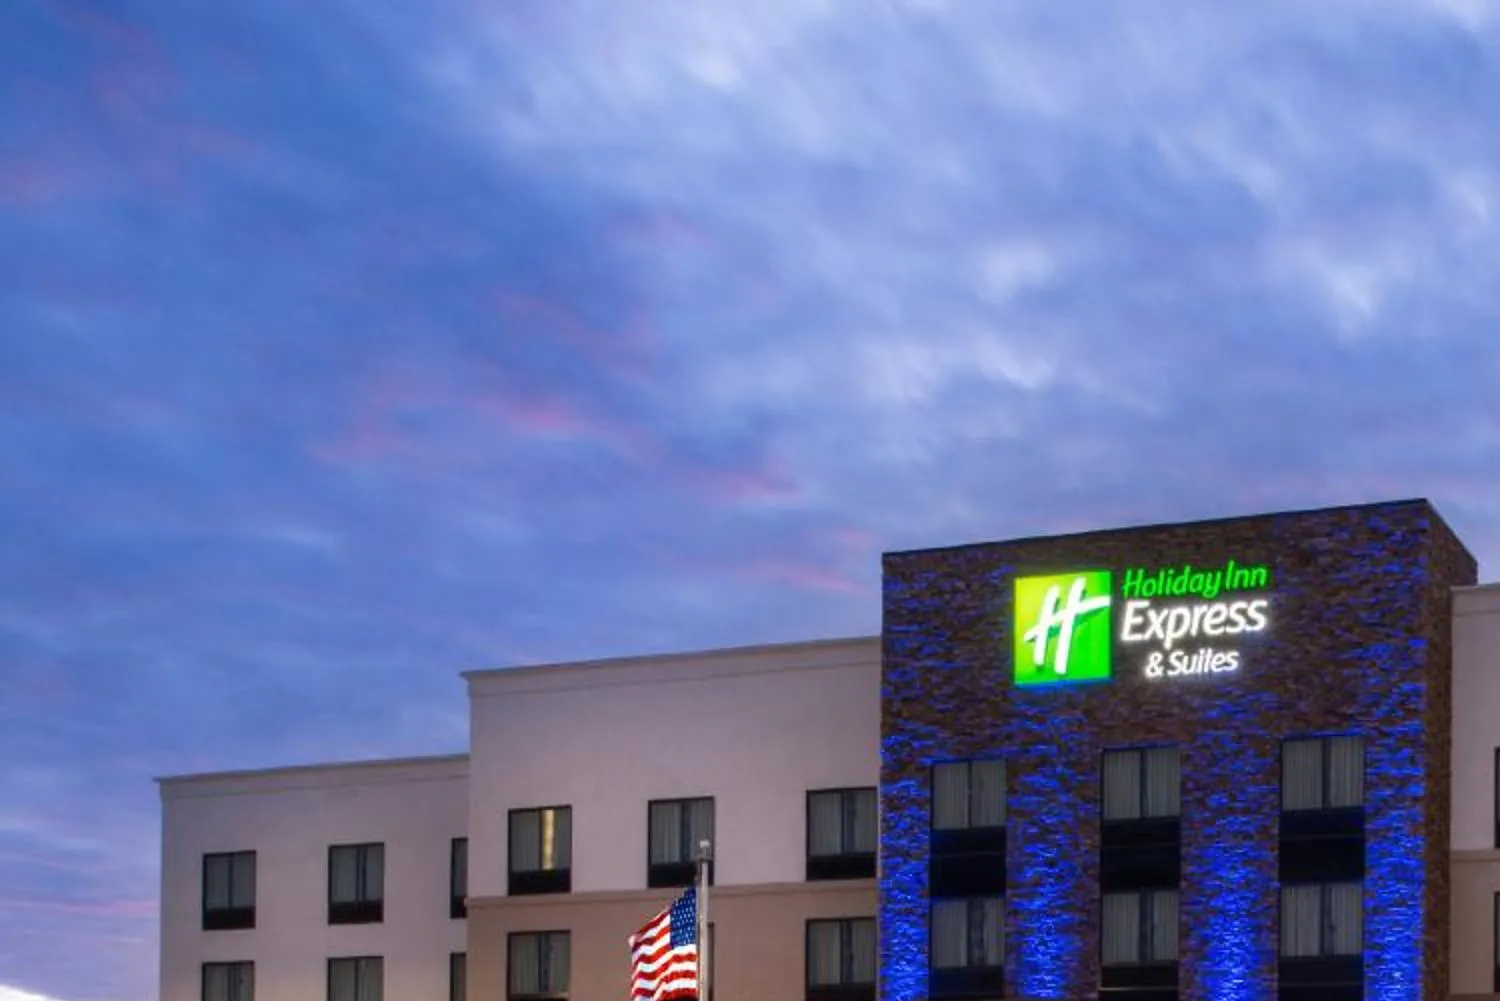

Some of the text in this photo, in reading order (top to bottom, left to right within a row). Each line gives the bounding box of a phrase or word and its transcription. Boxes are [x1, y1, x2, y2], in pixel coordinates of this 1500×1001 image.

[1121, 560, 1268, 598] Holiday Inn
[1120, 600, 1268, 650] Express
[1145, 648, 1240, 678] & Suites
